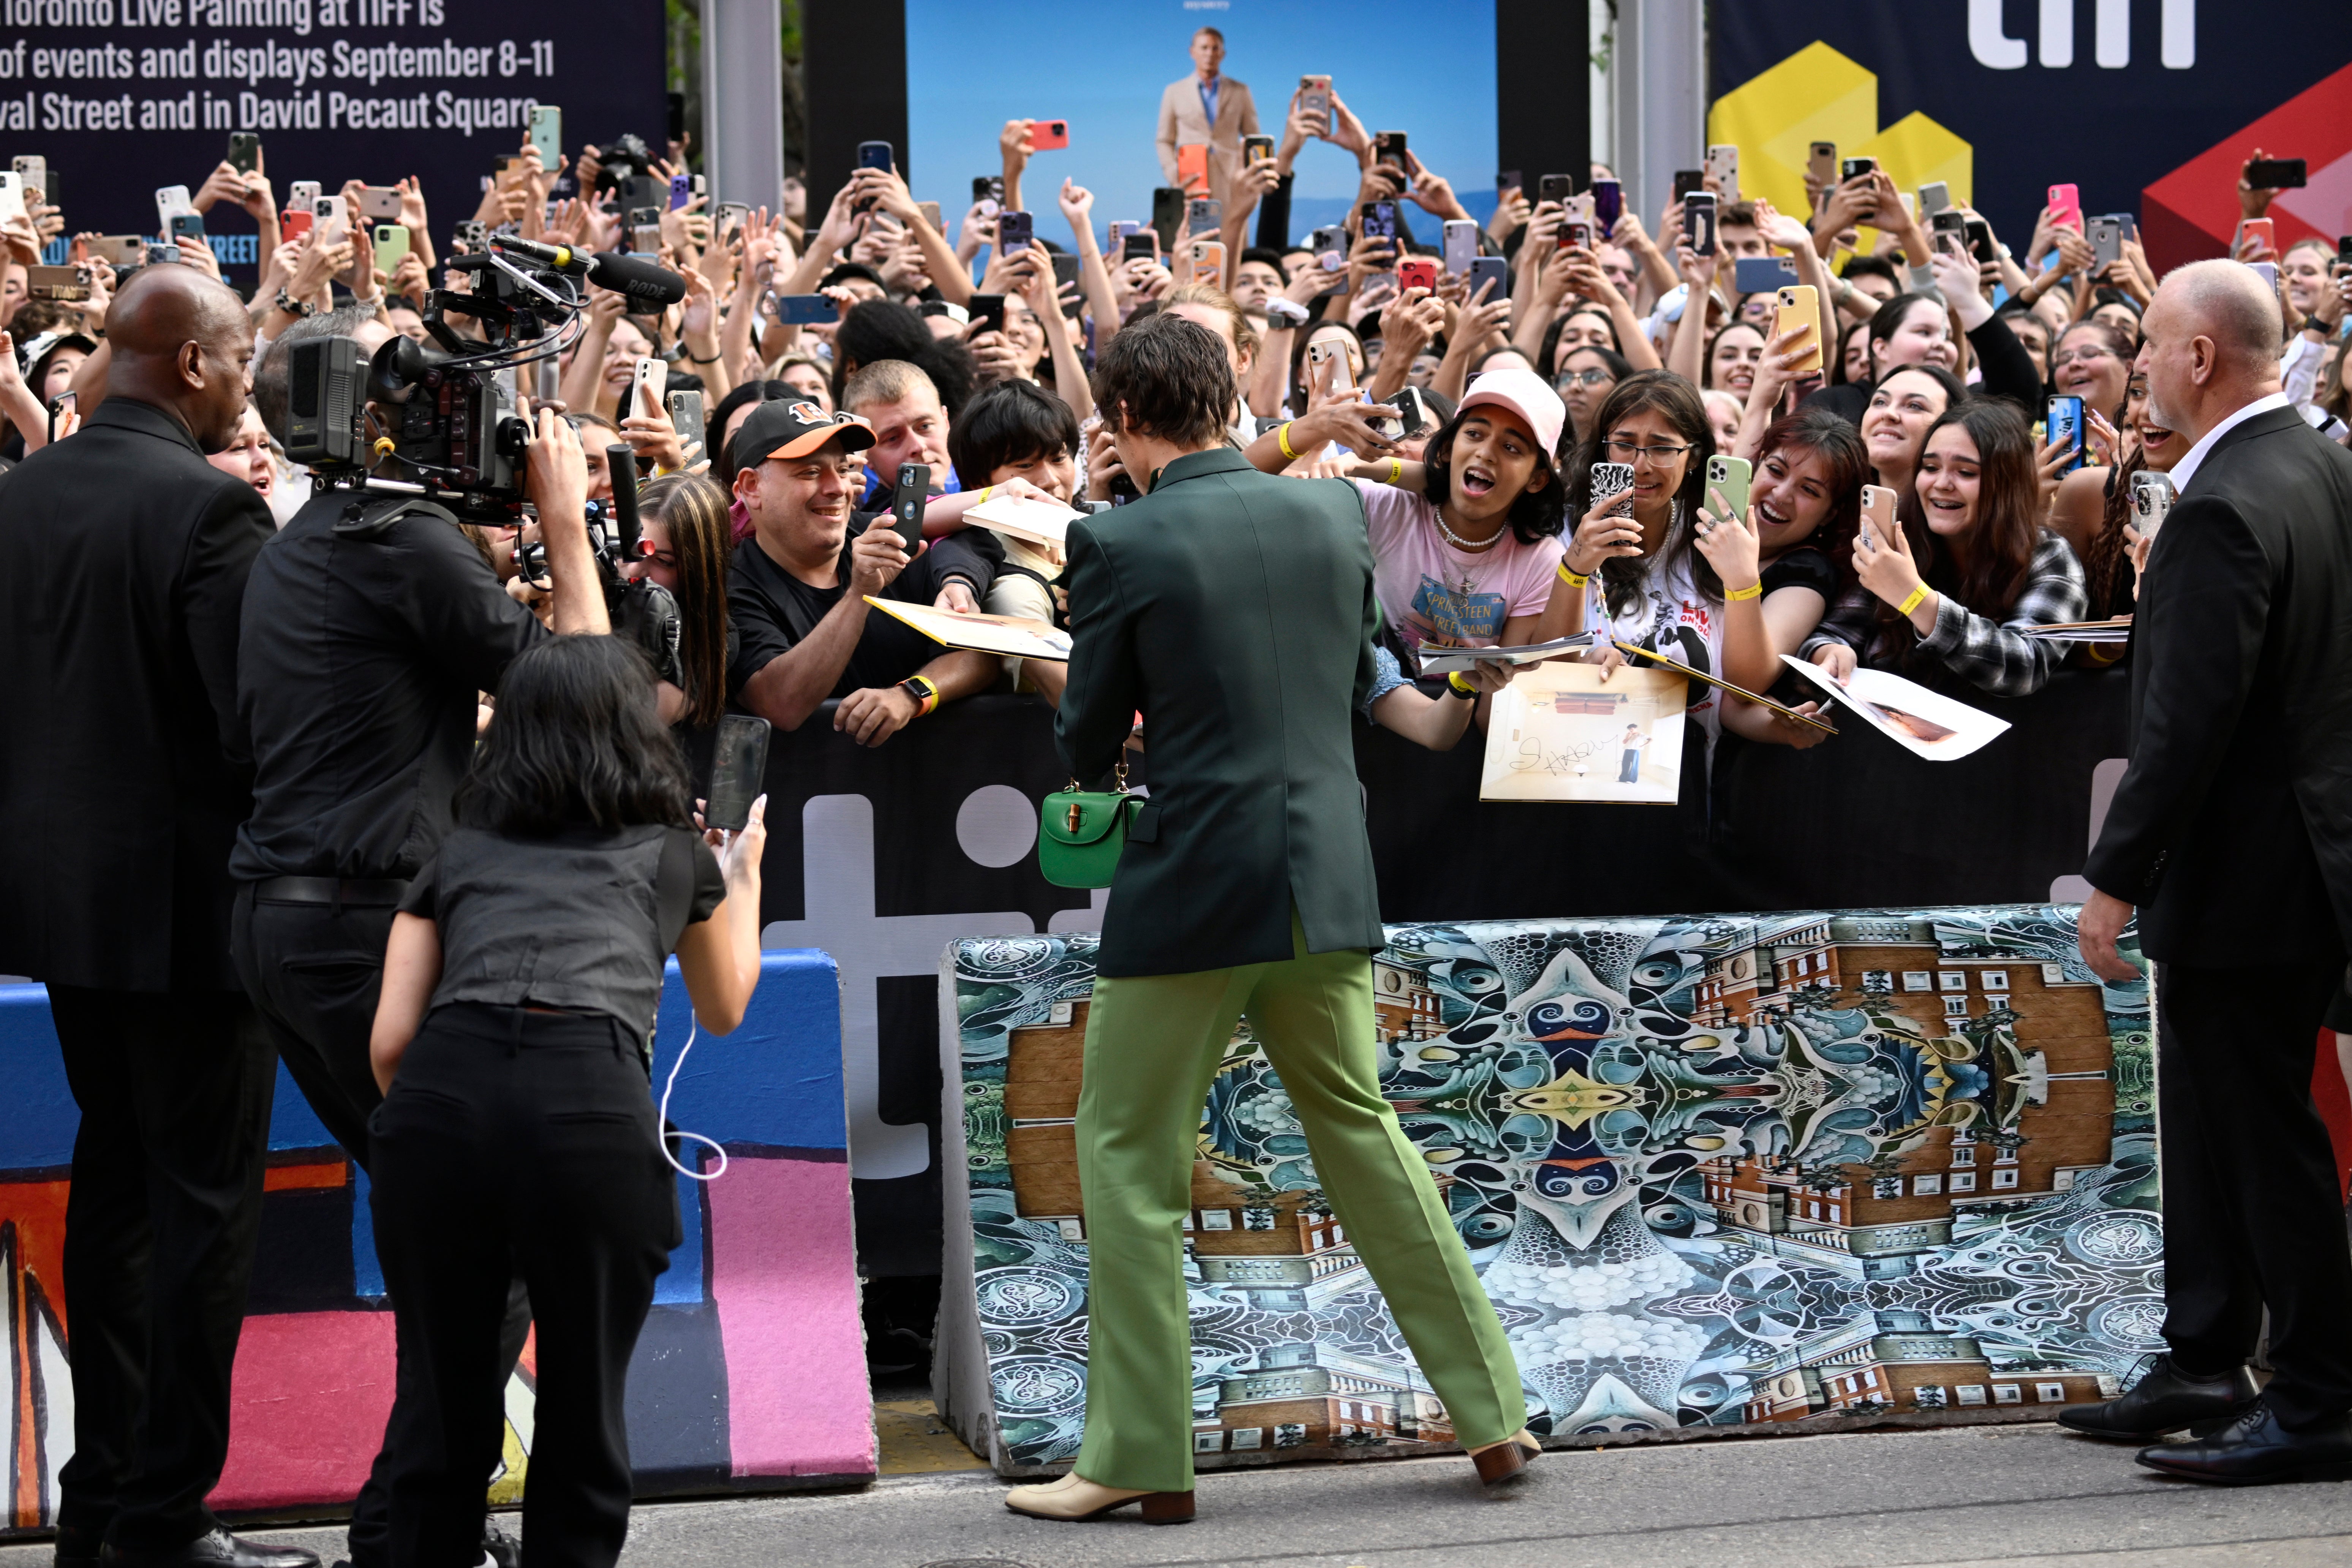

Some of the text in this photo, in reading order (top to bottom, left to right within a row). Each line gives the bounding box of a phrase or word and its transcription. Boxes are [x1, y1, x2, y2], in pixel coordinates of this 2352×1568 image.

[122, 0, 181, 26] Live
[189, 0, 311, 35] Painting
[319, 0, 349, 26] at
[358, 0, 412, 26] TIFF
[419, 0, 444, 26] is
[0, 39, 26, 78] of
[33, 42, 133, 78] events
[141, 39, 196, 78] and
[204, 39, 327, 87] displays
[333, 38, 493, 86] September
[43, 92, 134, 130] Street
[141, 91, 196, 130] and
[204, 91, 231, 130] in
[240, 90, 321, 130] David
[329, 91, 431, 129] Pecaut
[207, 235, 259, 265] TREET
[625, 279, 667, 299] RØDE
[1682, 600, 1711, 631] LOV
